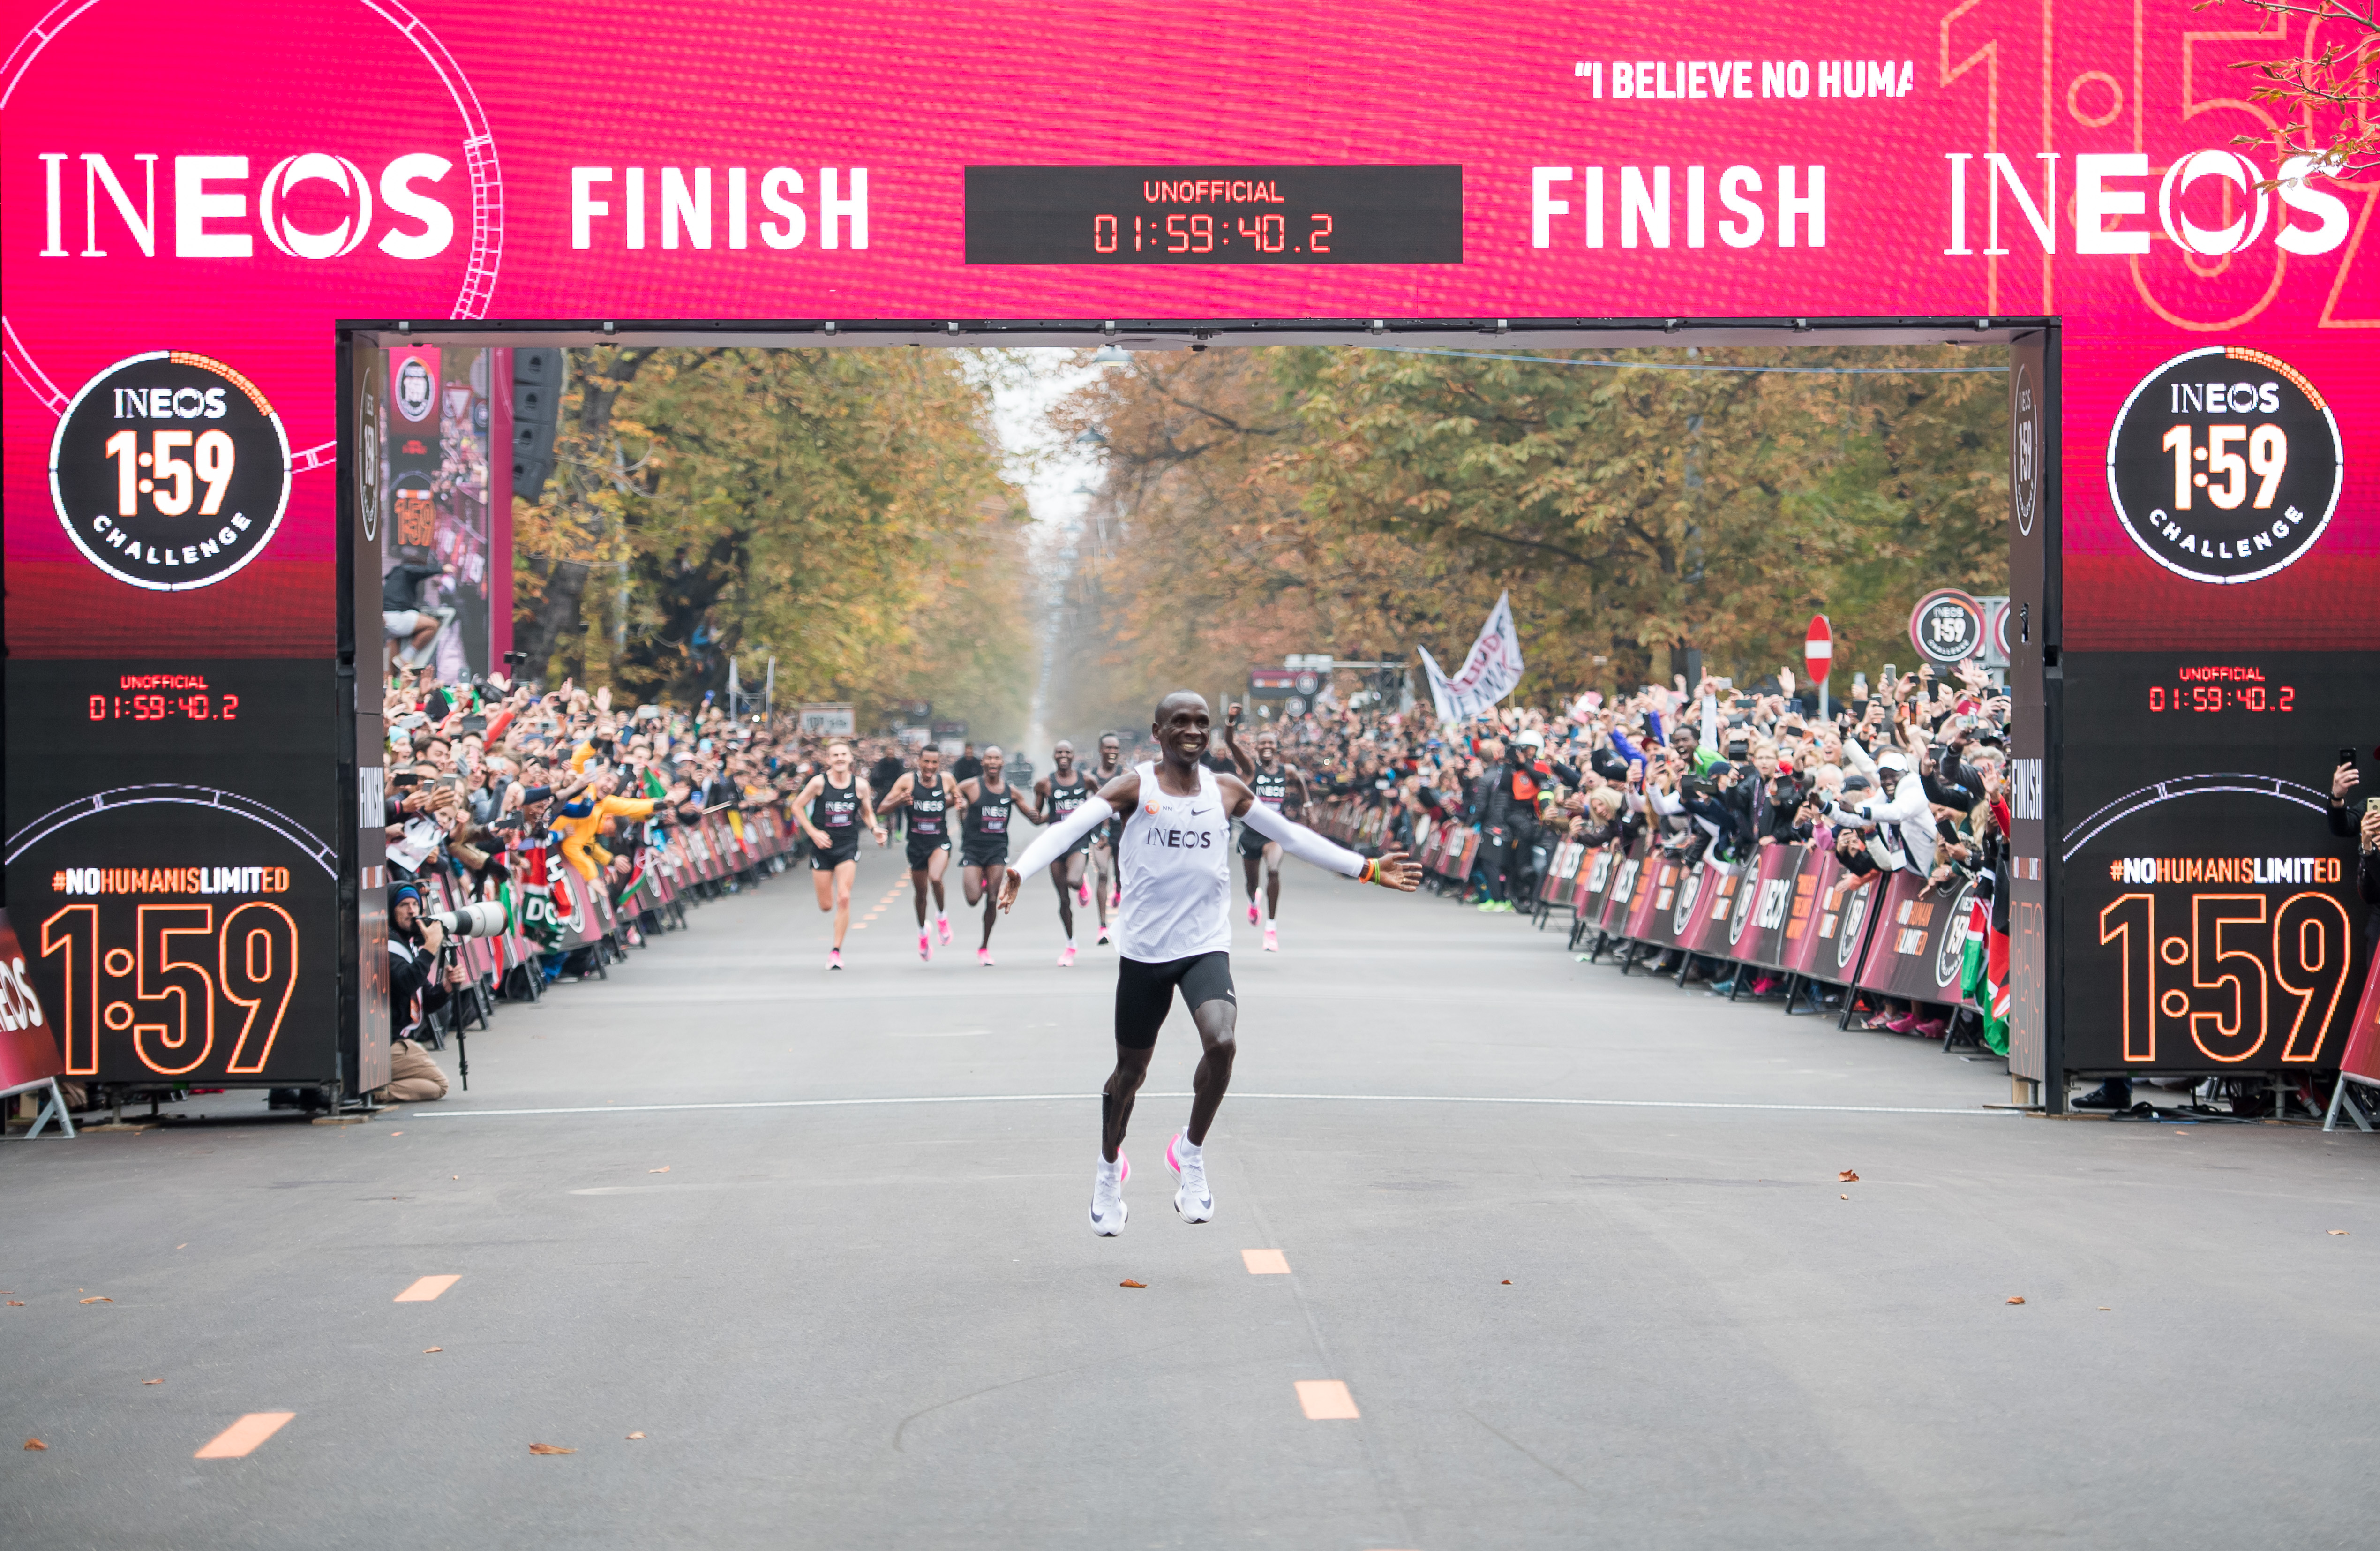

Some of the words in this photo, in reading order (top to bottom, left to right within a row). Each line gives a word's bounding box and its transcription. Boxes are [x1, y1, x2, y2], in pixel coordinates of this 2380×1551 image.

[1612, 61, 1753, 98] BELIEVE
[1762, 60, 1809, 98] NO
[39, 153, 453, 259] INEOS
[571, 166, 869, 250] FINISH
[1144, 180, 1284, 203] UNOFFICIAL
[1532, 165, 1826, 248] FINISH
[1944, 149, 2350, 256] INEOS
[1094, 213, 1332, 253] 01:59:40.2
[113, 388, 227, 419] INEOS
[2170, 382, 2280, 413] INEOS
[105, 429, 235, 516] 1:59
[2162, 423, 2288, 511] 1:59
[93, 512, 252, 566] CHALLENGE
[2149, 505, 2304, 559] CHALLENGE
[120, 675, 209, 690] UNOFFICIAL
[2179, 666, 2266, 682] UNOFFICIAL
[90, 694, 239, 721] 01:59:40.2
[2149, 685, 2296, 712] 01:59:40.2
[2011, 758, 2042, 820] FINISH
[1146, 827, 1211, 849] INEOS
[51, 866, 290, 895] #NOHUMANISLIMITED
[2110, 857, 2341, 884] #NOHUMANISLIMITED
[41, 901, 299, 1075] 1:59
[2100, 891, 2351, 1062] 1:59
